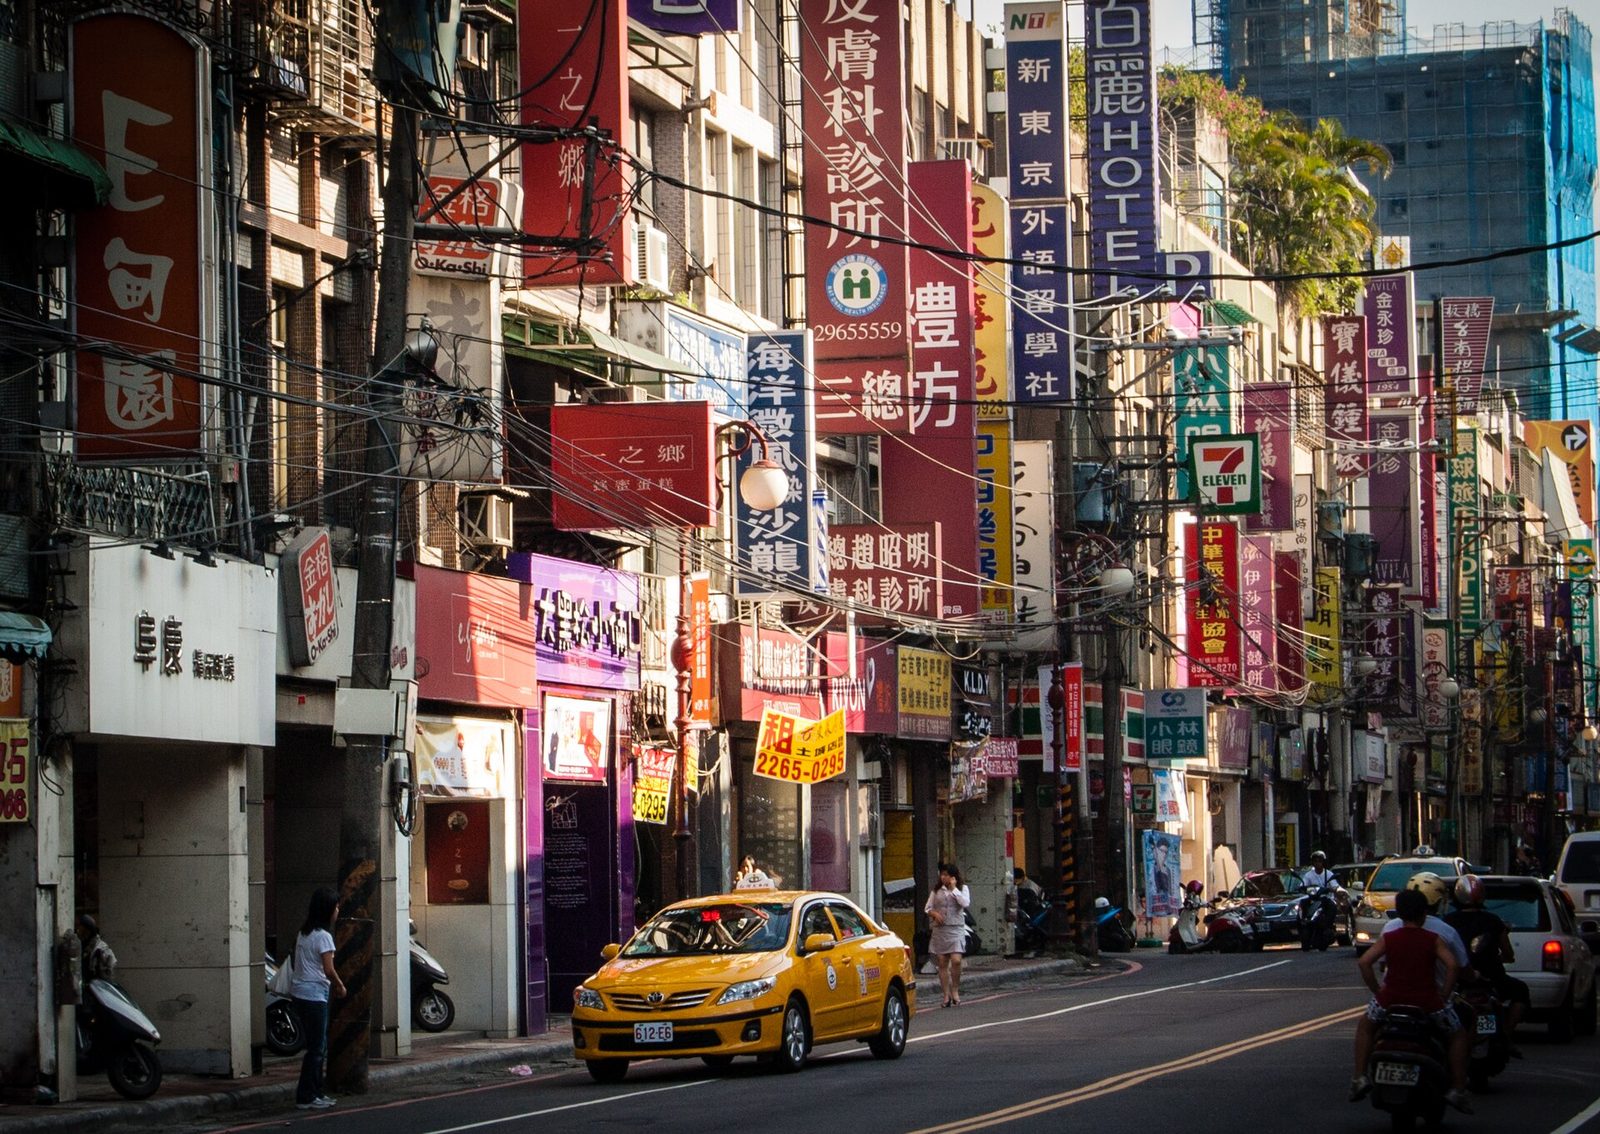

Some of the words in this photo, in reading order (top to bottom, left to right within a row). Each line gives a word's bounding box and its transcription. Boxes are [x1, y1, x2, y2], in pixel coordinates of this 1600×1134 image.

[1010, 11, 1064, 30] NTF
[1018, 58, 1053, 187] 新東京
[814, 321, 903, 343] 29655559
[1375, 292, 1395, 345] 金永珍
[816, 369, 904, 421] 三總
[578, 444, 686, 465] 一之鄉
[1380, 422, 1401, 475] 金珍
[303, 542, 329, 593] 金格
[1201, 622, 1227, 654] 協會
[761, 713, 795, 756] 租
[1150, 720, 1199, 737] 小林
[1151, 739, 1198, 755] 眼鏡
[756, 751, 844, 781] 2265-0295
